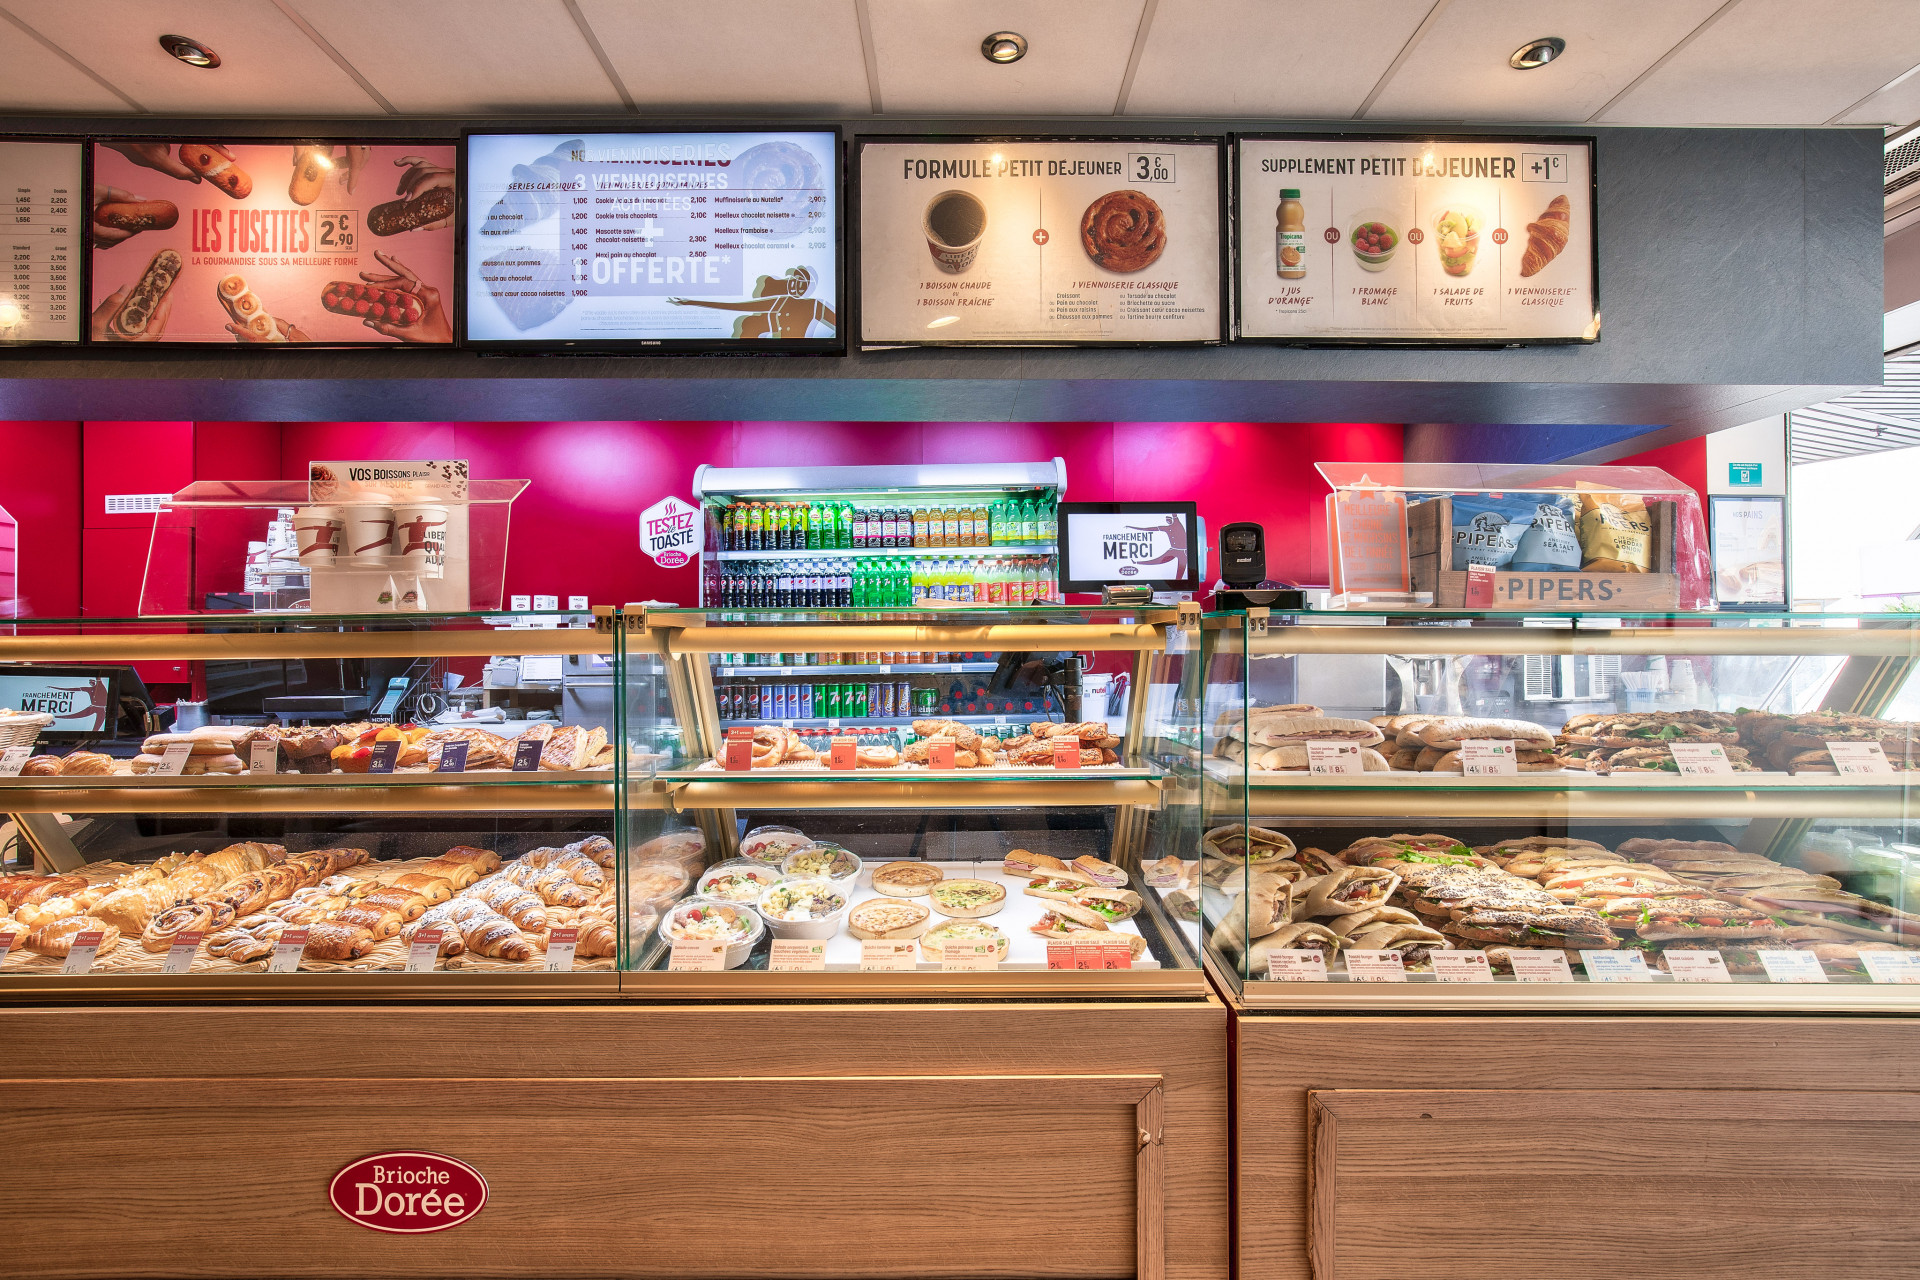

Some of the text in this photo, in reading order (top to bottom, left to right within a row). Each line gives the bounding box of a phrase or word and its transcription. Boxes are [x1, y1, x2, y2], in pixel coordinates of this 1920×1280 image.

[904, 159, 992, 179] FORMULE
[998, 159, 1043, 178] PETIT
[1049, 158, 1122, 176] DÉJEUNER
[1261, 157, 1356, 175] SUPPLÉMENT
[1361, 157, 1407, 176] PETIT
[572, 212, 588, 220] 1,20€
[596, 212, 707, 220] Cookie trois chocolats 2,10€
[192, 209, 222, 253] LES
[229, 209, 310, 254] FUSETTES
[572, 228, 588, 236] 1,40€
[741, 227, 769, 235] framboise
[1326, 231, 1339, 241] OU
[1494, 231, 1507, 241] OU
[1280, 232, 1303, 241] Tropicana
[1410, 232, 1423, 241] OU
[192, 257, 358, 266] LA GOURMANDISE SOUS SA MEILLEURE FORME
[925, 282, 958, 290] BOISSON
[960, 282, 992, 290] CHAUDE
[1078, 281, 1135, 289] VIENNOISERIE
[1136, 281, 1179, 291] CLASSIQUE
[572, 290, 588, 298] 1,90€
[1286, 287, 1301, 298] JUS
[1358, 287, 1397, 296] FROMAGE
[1444, 298, 1473, 306] FRUITS
[1521, 298, 1564, 307] CLASSIQUE
[349, 468, 371, 481] VOS
[373, 469, 411, 480] BOISSONS
[379, 480, 413, 489] MESURE
[1344, 504, 1392, 516] MEILLEURE
[1744, 510, 1763, 520] PAINS
[647, 512, 693, 536] TESTEZ
[1531, 516, 1573, 532] PIPER
[1600, 514, 1649, 532] PIPERS
[649, 528, 694, 551] TOASTÉ
[1102, 531, 1154, 542] FRANCHEMENT
[1456, 531, 1514, 549] PIPERS
[1560, 544, 1574, 552] SALT
[1613, 538, 1643, 548] CHEDDAR
[1103, 541, 1154, 560] MERCI
[1621, 545, 1642, 553] ONION
[660, 556, 685, 564] Dorée
[1508, 578, 1614, 600] PIPERS
[22, 692, 75, 700] FRANCHEMENT
[21, 699, 72, 713] MERCI
[373, 1165, 450, 1185] Brioche
[355, 1183, 465, 1217] Dorée
